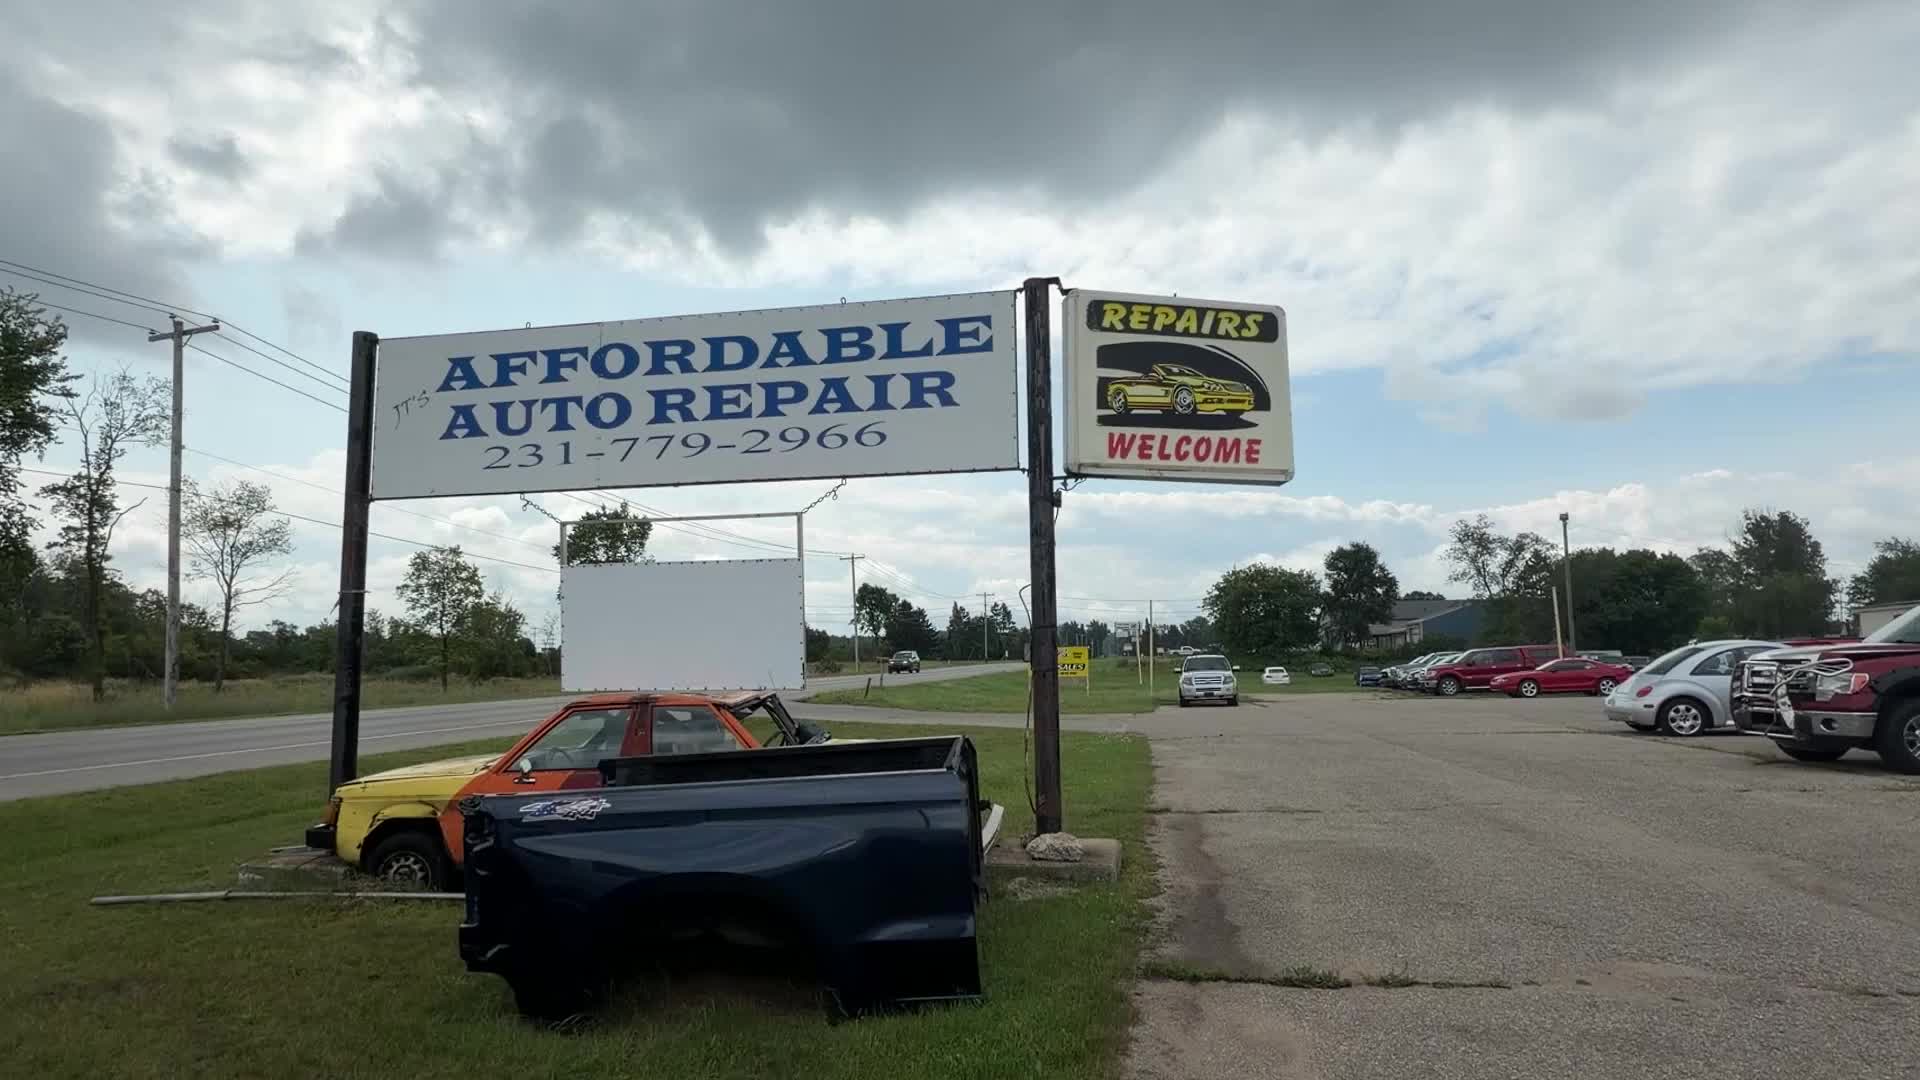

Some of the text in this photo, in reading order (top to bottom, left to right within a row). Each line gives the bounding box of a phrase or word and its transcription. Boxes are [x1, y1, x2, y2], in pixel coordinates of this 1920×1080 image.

[1102, 302, 1264, 338] REPAIRS
[435, 314, 995, 394] AFFORDABLE
[438, 370, 961, 442] AUTO REPAIR
[482, 421, 888, 471] 231-779-2966
[1106, 431, 1262, 465] WELCOME
